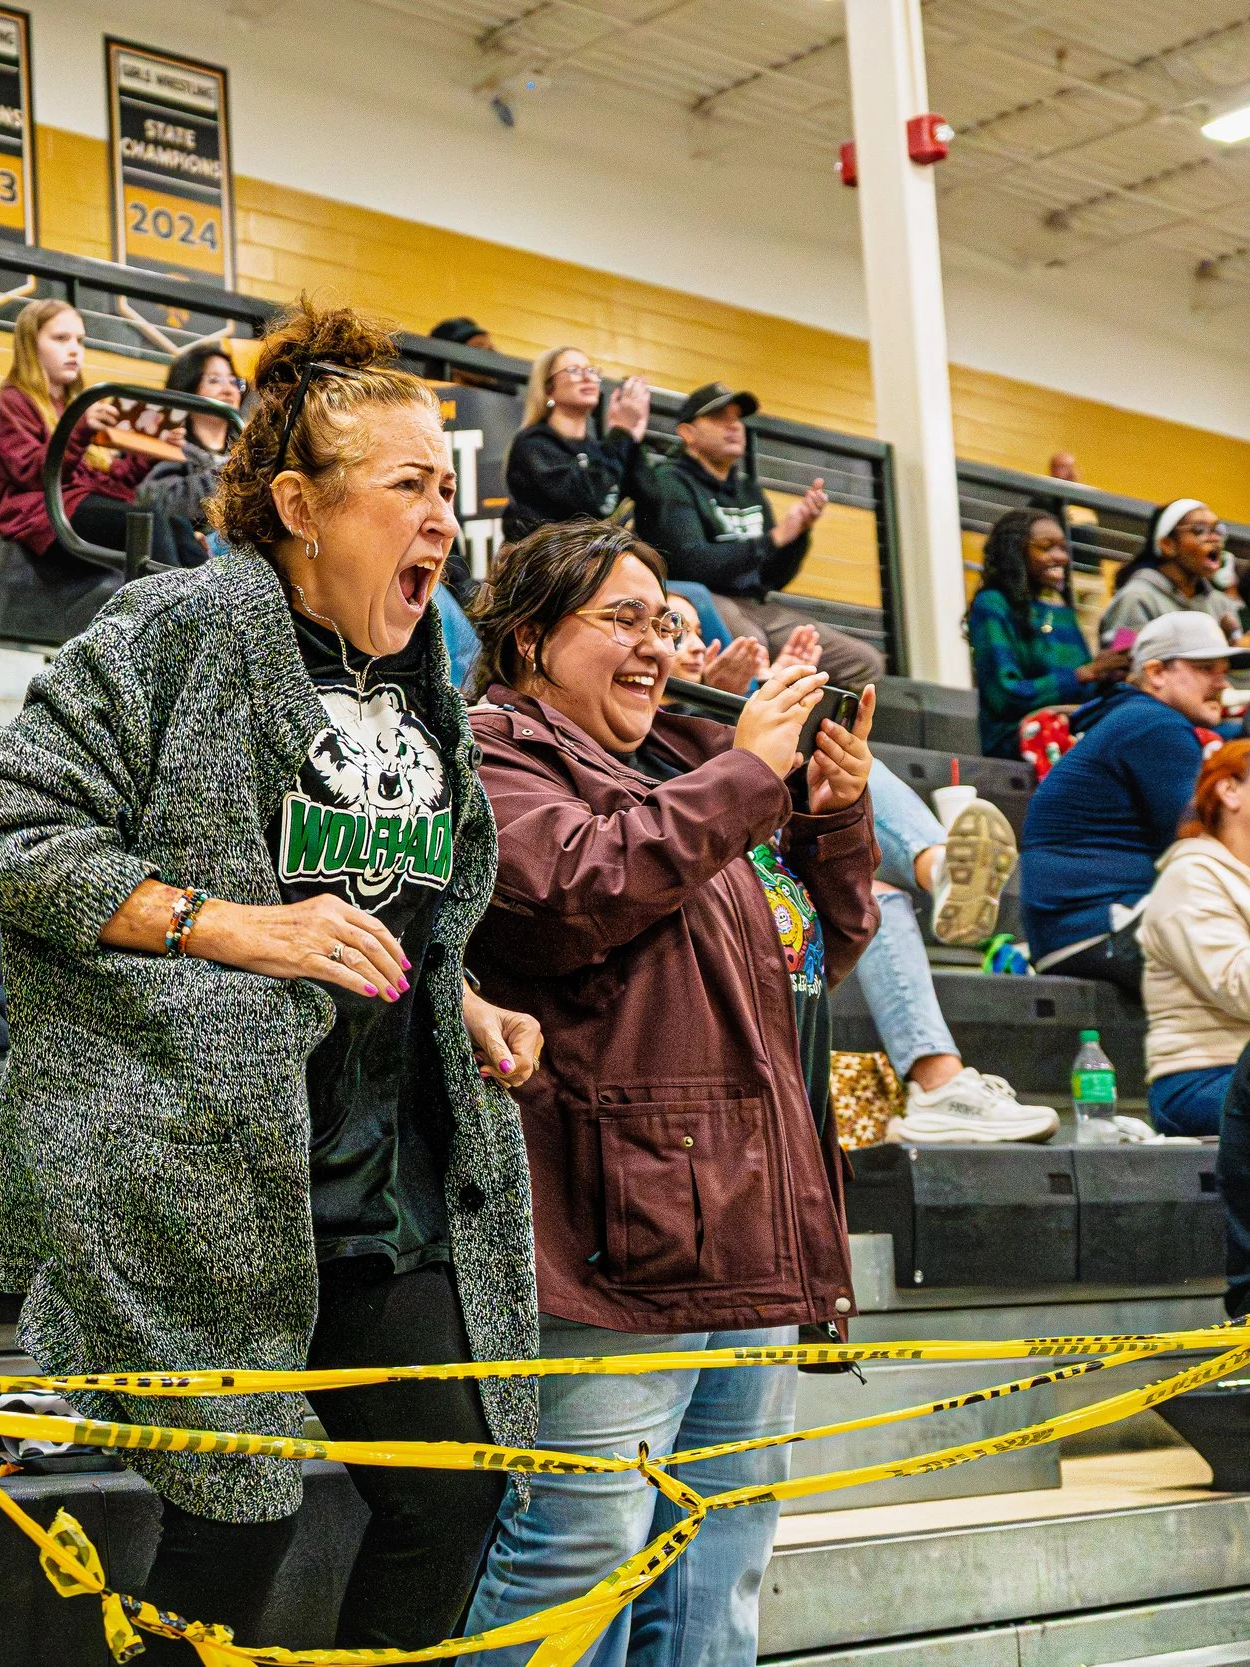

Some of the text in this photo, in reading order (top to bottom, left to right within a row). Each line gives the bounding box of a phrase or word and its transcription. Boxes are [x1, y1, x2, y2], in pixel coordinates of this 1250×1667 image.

[143, 118, 197, 150] STATE
[120, 136, 223, 180] CHAMPIONS
[128, 202, 219, 251] 2024
[285, 797, 453, 884] WOLFPACK
